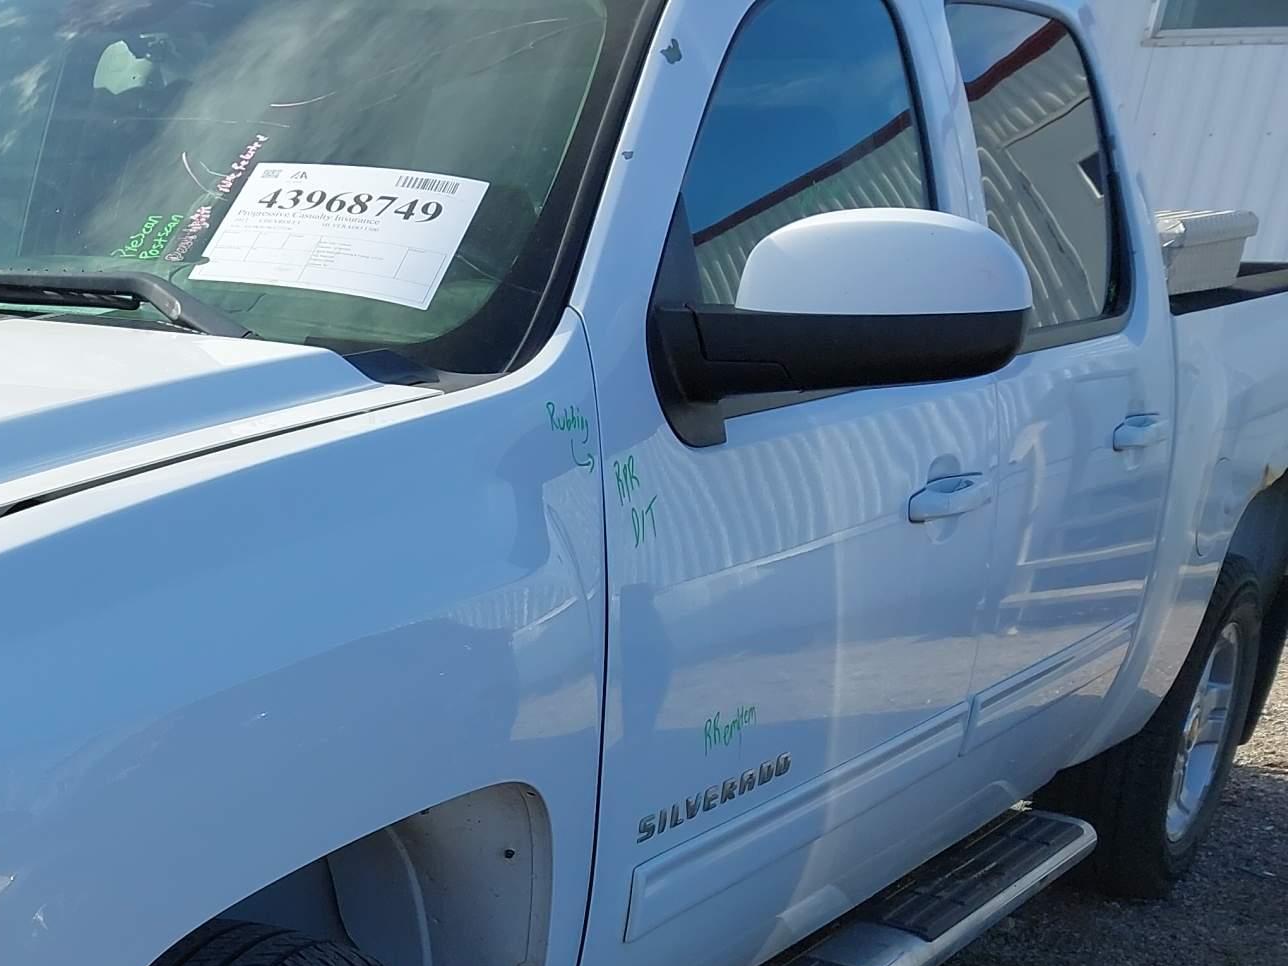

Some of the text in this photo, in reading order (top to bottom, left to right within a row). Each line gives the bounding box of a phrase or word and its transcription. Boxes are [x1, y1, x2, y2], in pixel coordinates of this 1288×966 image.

[237, 208, 381, 225] Progressive Casualty Insurance
[258, 188, 444, 223] 43968749
[546, 402, 589, 444] Rubbing
[636, 751, 793, 844] SILVERADO
